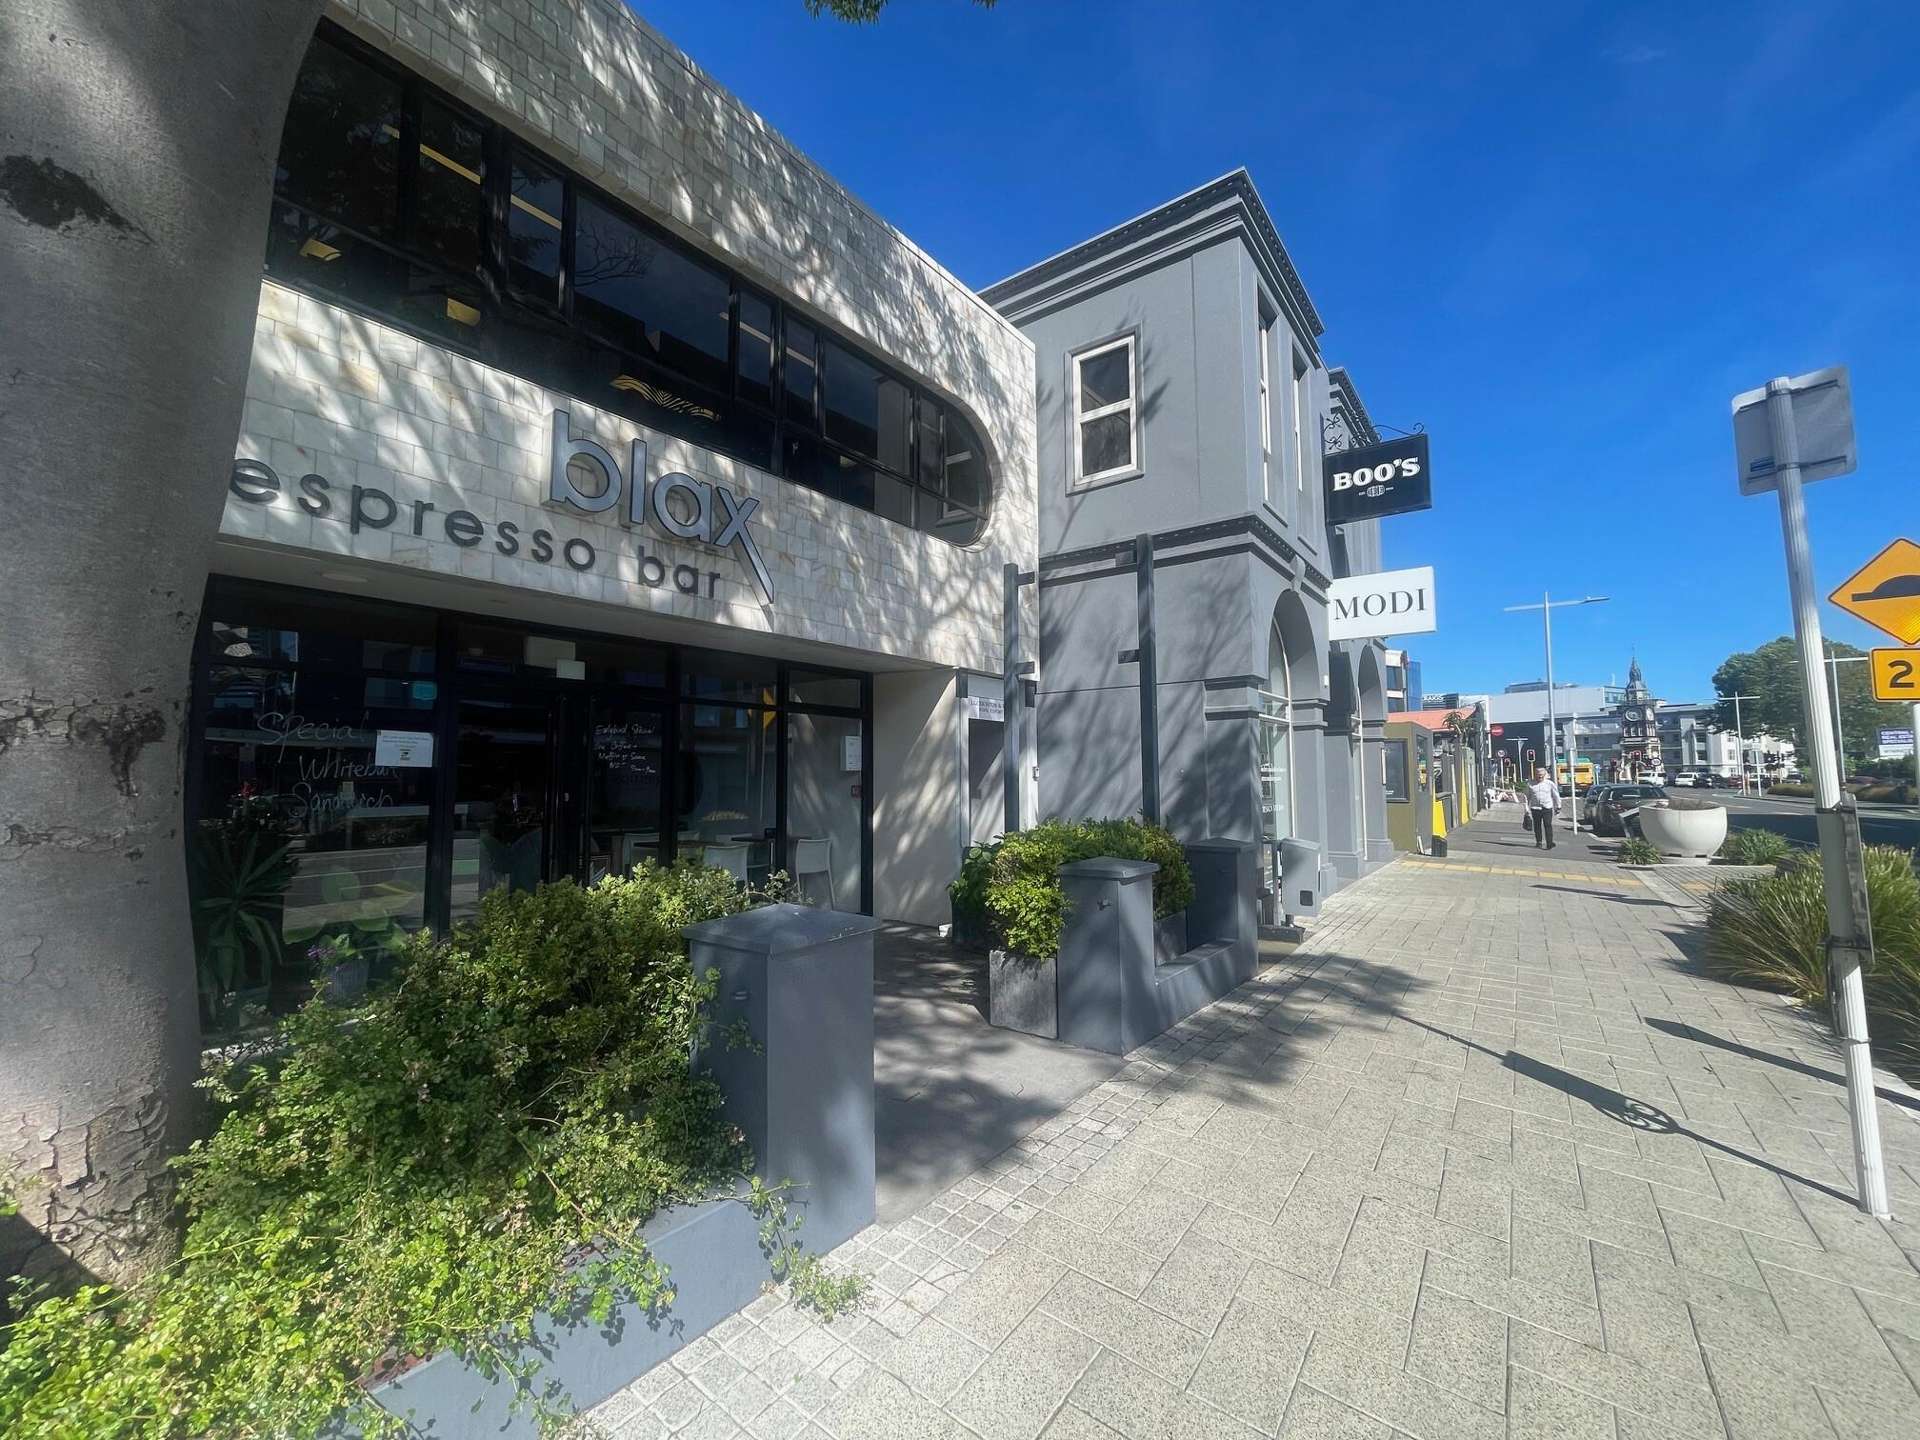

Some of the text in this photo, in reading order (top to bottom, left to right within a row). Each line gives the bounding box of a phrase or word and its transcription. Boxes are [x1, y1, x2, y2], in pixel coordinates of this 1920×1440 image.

[1332, 457, 1421, 492] BOO'S
[547, 408, 774, 605] blax
[229, 457, 721, 601] espresso bar
[1334, 587, 1427, 621] MODI
[1887, 659, 1915, 689] 2
[257, 710, 370, 764] Special
